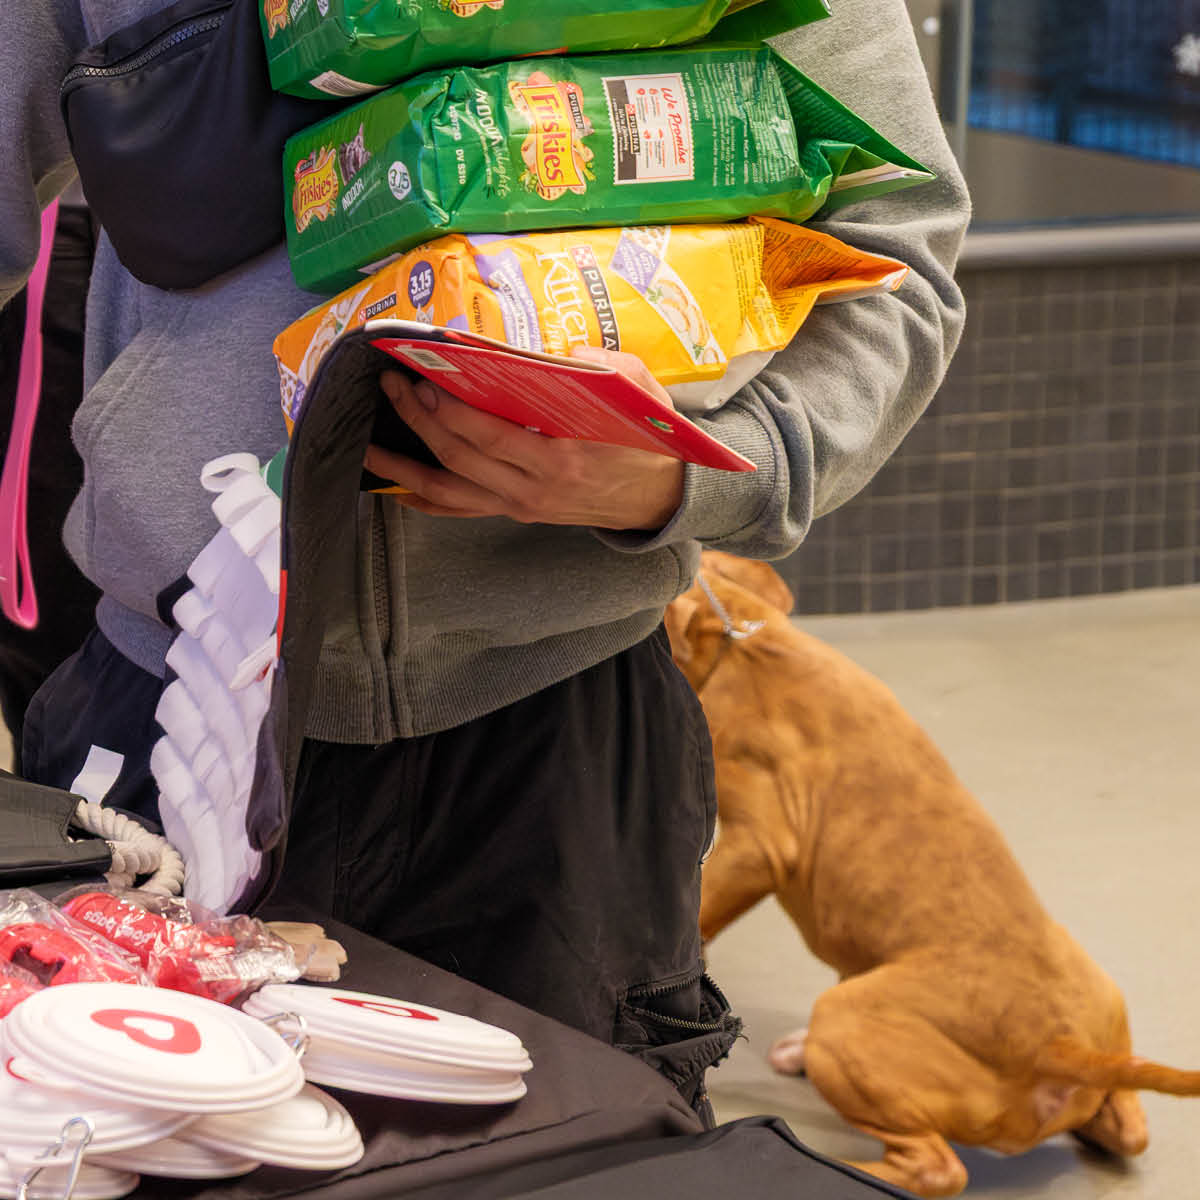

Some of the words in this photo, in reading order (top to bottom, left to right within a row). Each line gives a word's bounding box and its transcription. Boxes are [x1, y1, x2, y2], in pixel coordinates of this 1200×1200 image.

[569, 93, 584, 129] PURINA
[660, 87, 678, 110] We
[669, 112, 688, 165] Promise
[531, 93, 567, 183] Friskies
[629, 114, 640, 152] PURINA
[299, 175, 333, 209] Friskies
[341, 178, 364, 211] INDOOR
[409, 268, 432, 295] 3.15
[366, 294, 397, 319] PURINA
[582, 268, 618, 351] PURINA
